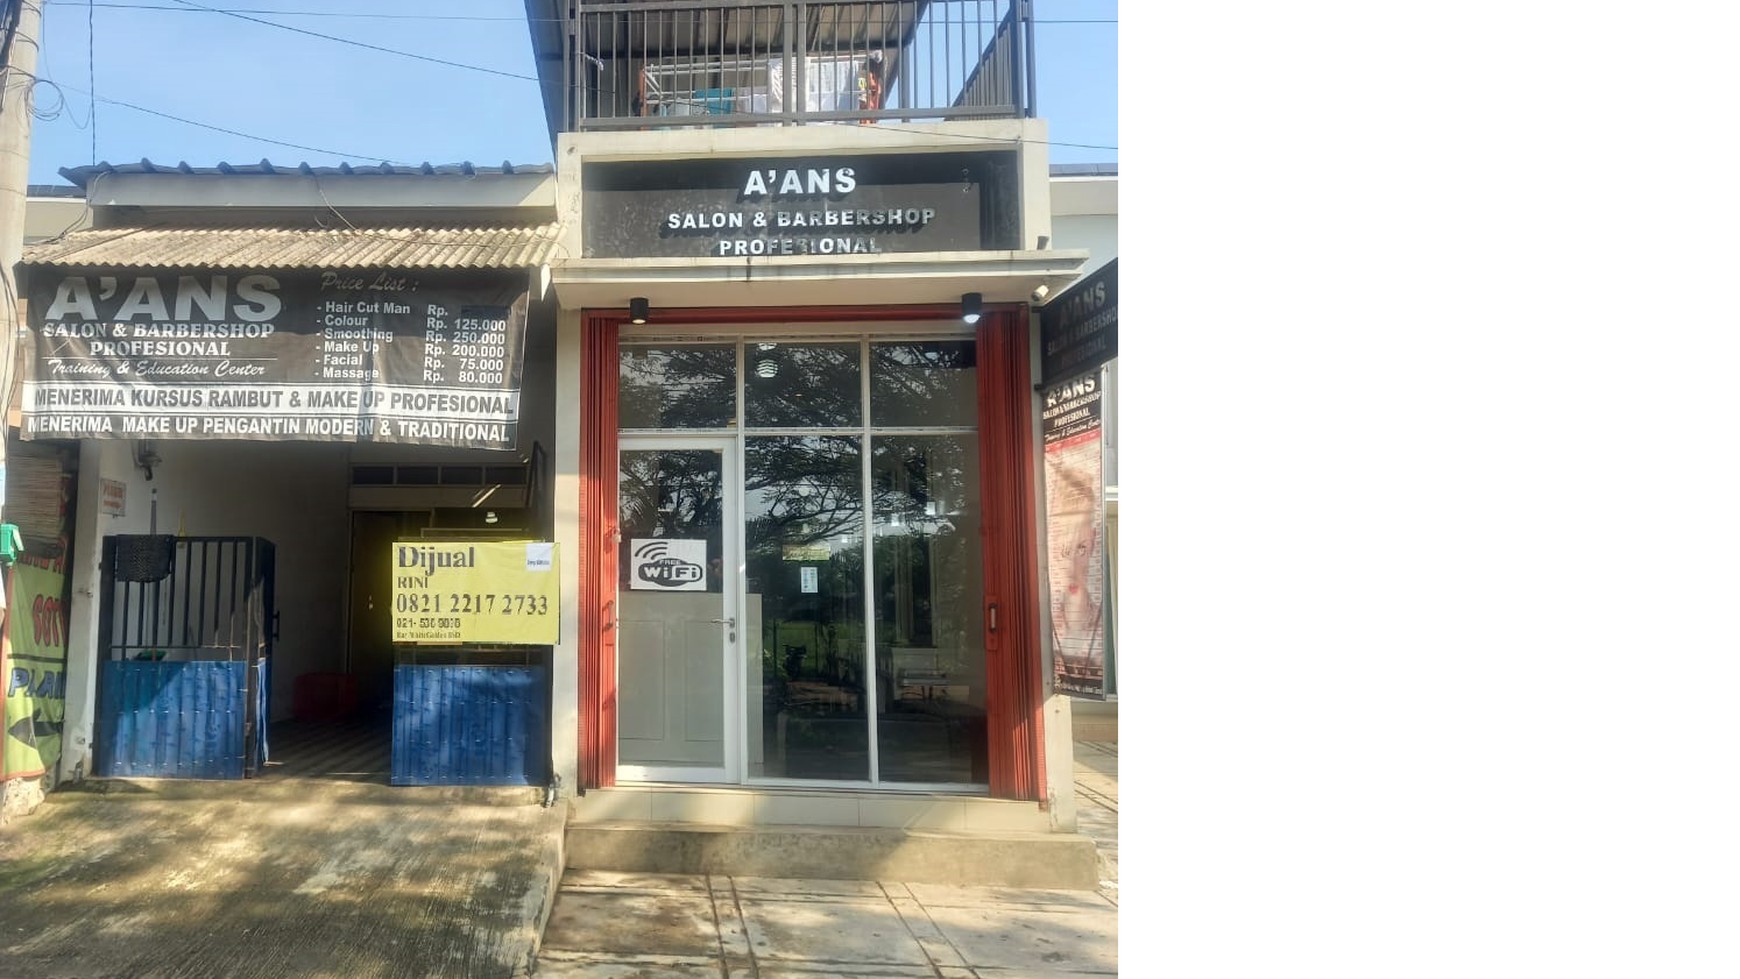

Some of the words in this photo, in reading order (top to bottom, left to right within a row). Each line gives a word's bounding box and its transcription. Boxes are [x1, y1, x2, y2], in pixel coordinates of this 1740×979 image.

[744, 168, 856, 195] A'ANS
[668, 212, 743, 229] SALON
[753, 211, 767, 228] &
[777, 208, 936, 227] BARBERSHOP
[321, 271, 364, 291] Price
[368, 271, 406, 291] List
[45, 274, 282, 322] A'ANS
[325, 302, 353, 313] Hair
[357, 302, 380, 313] Cut
[383, 303, 411, 314] Man
[427, 304, 449, 317] Rp.
[325, 315, 369, 326] Colour
[426, 317, 448, 330] Rp.
[454, 318, 506, 332] 125.000
[42, 323, 107, 338] SALON
[113, 323, 127, 338] &
[133, 323, 275, 338] BARBERSHOP
[324, 328, 393, 342] Smoothing
[426, 330, 447, 343] Rp.
[452, 331, 505, 345] 250.000
[90, 340, 231, 356] PROFESIONAL
[324, 341, 358, 352] Make
[363, 341, 379, 355] Up
[425, 344, 446, 357] Rp.
[452, 344, 505, 358] 200.000
[323, 354, 363, 366] Facial
[424, 357, 445, 370] Rp.
[459, 358, 504, 371] 75.000
[48, 360, 111, 379] Training
[116, 360, 130, 375] &
[135, 361, 209, 377] Education
[215, 360, 266, 377] Center
[323, 367, 379, 381] Massage
[423, 370, 445, 382] Rp.
[458, 371, 503, 384] 80.000
[34, 388, 126, 408] MENERIMA
[131, 388, 203, 408] KURSUS
[208, 390, 284, 408] RAMBUT
[289, 391, 301, 408] &
[307, 391, 358, 409] MAKE
[363, 391, 385, 409] UP
[390, 392, 514, 415] PROFESIONAL
[27, 415, 113, 433] MENERIMA
[122, 416, 170, 433] MAKE
[175, 416, 199, 433] UP
[203, 417, 300, 435] PENGANTIN
[305, 418, 374, 436] MODERN
[379, 420, 392, 436] &
[397, 421, 509, 442] TRADITIONAL
[398, 546, 475, 576] Dijual
[397, 576, 429, 589] RINI
[397, 593, 440, 613] 0821
[450, 593, 496, 614] 2217
[502, 595, 548, 616] 2733
